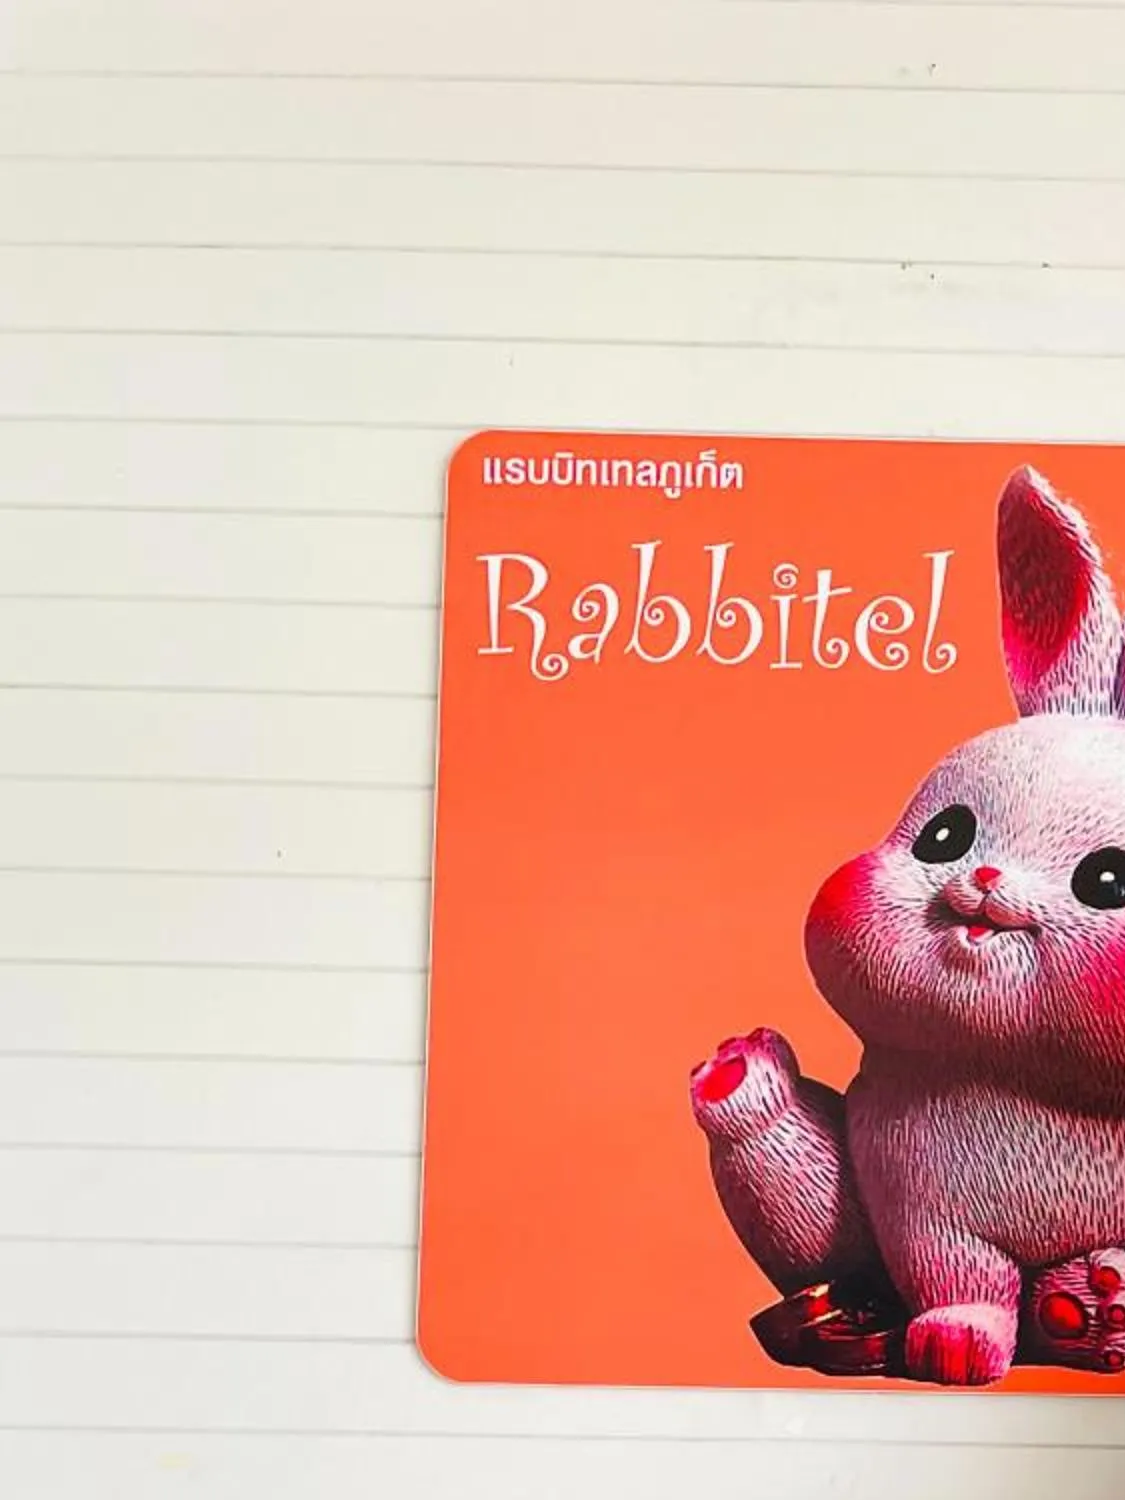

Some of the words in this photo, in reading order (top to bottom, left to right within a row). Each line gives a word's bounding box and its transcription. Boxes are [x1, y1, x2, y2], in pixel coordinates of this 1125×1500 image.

[482, 448, 744, 499] แรบบิทเทลภูเก็ต
[476, 540, 958, 682] Rabbitel
